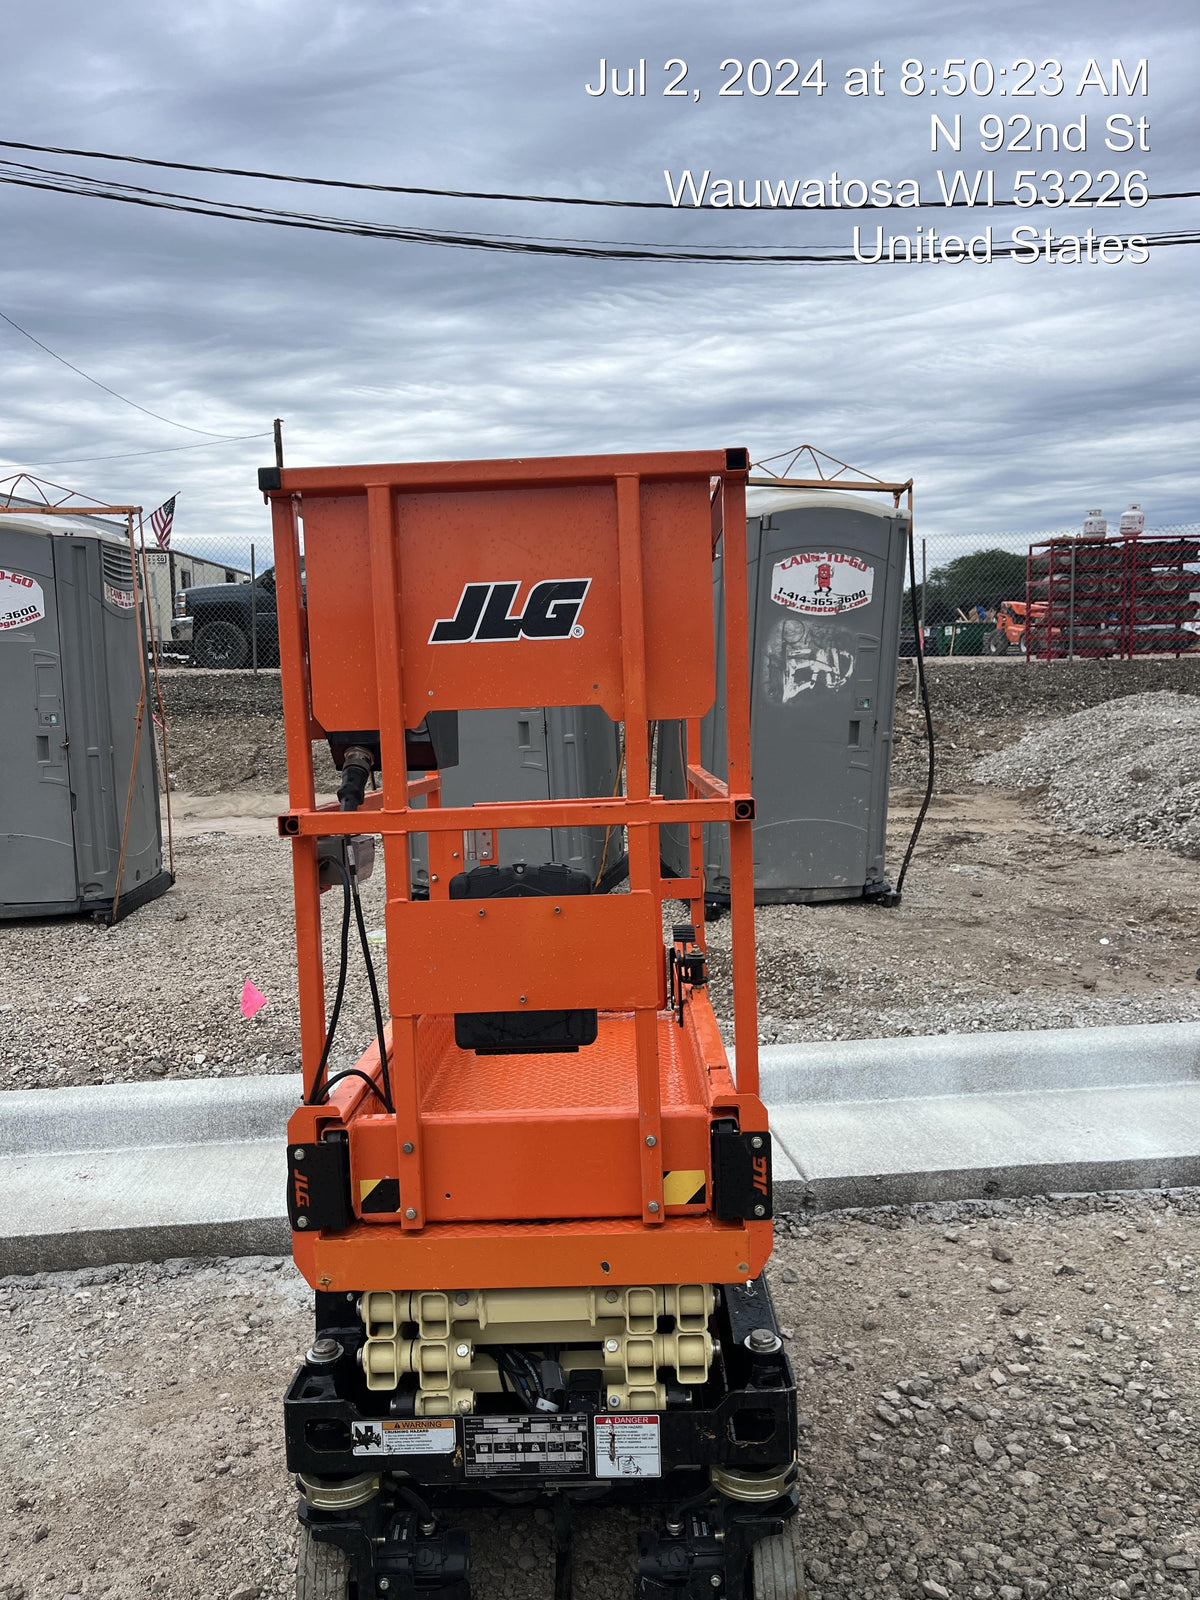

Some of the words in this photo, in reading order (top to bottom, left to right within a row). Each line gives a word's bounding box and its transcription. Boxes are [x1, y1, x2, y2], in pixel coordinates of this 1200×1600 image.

[779, 587, 866, 605] 1-414-365-3600
[427, 577, 593, 645] JLG
[294, 1168, 310, 1208] JLG
[752, 1156, 768, 1196] JLG
[402, 1420, 442, 1429] WARNING
[614, 1416, 649, 1424] DANGER
